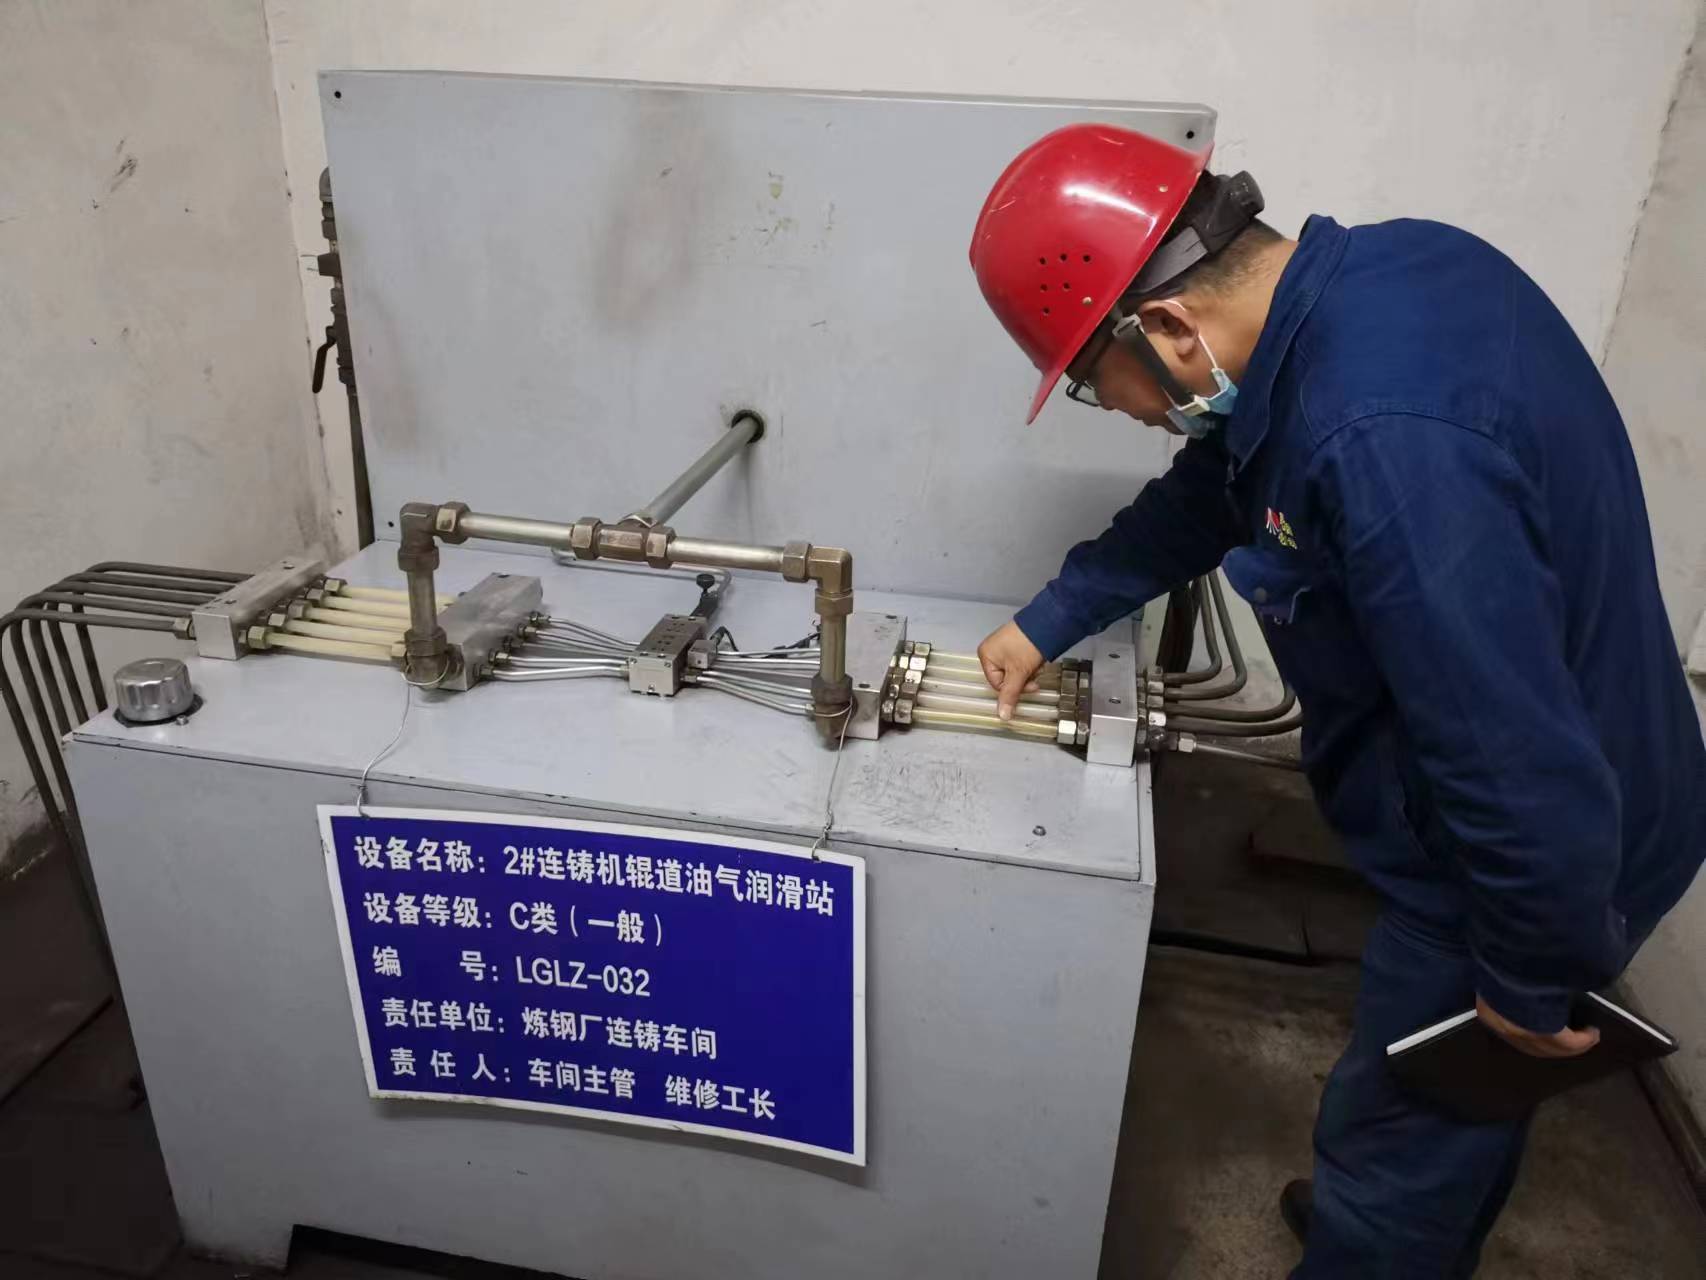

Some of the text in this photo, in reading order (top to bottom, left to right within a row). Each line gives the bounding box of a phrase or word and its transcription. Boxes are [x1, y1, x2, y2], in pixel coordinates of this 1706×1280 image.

[503, 845, 835, 917] 2#连铸机辊道油气润滑站
[516, 956, 651, 997] LGLZ-032
[521, 1006, 718, 1060] 炼钢厂连铸车间
[528, 1057, 636, 1100] 车间主管
[665, 1074, 776, 1120] 维修工长
